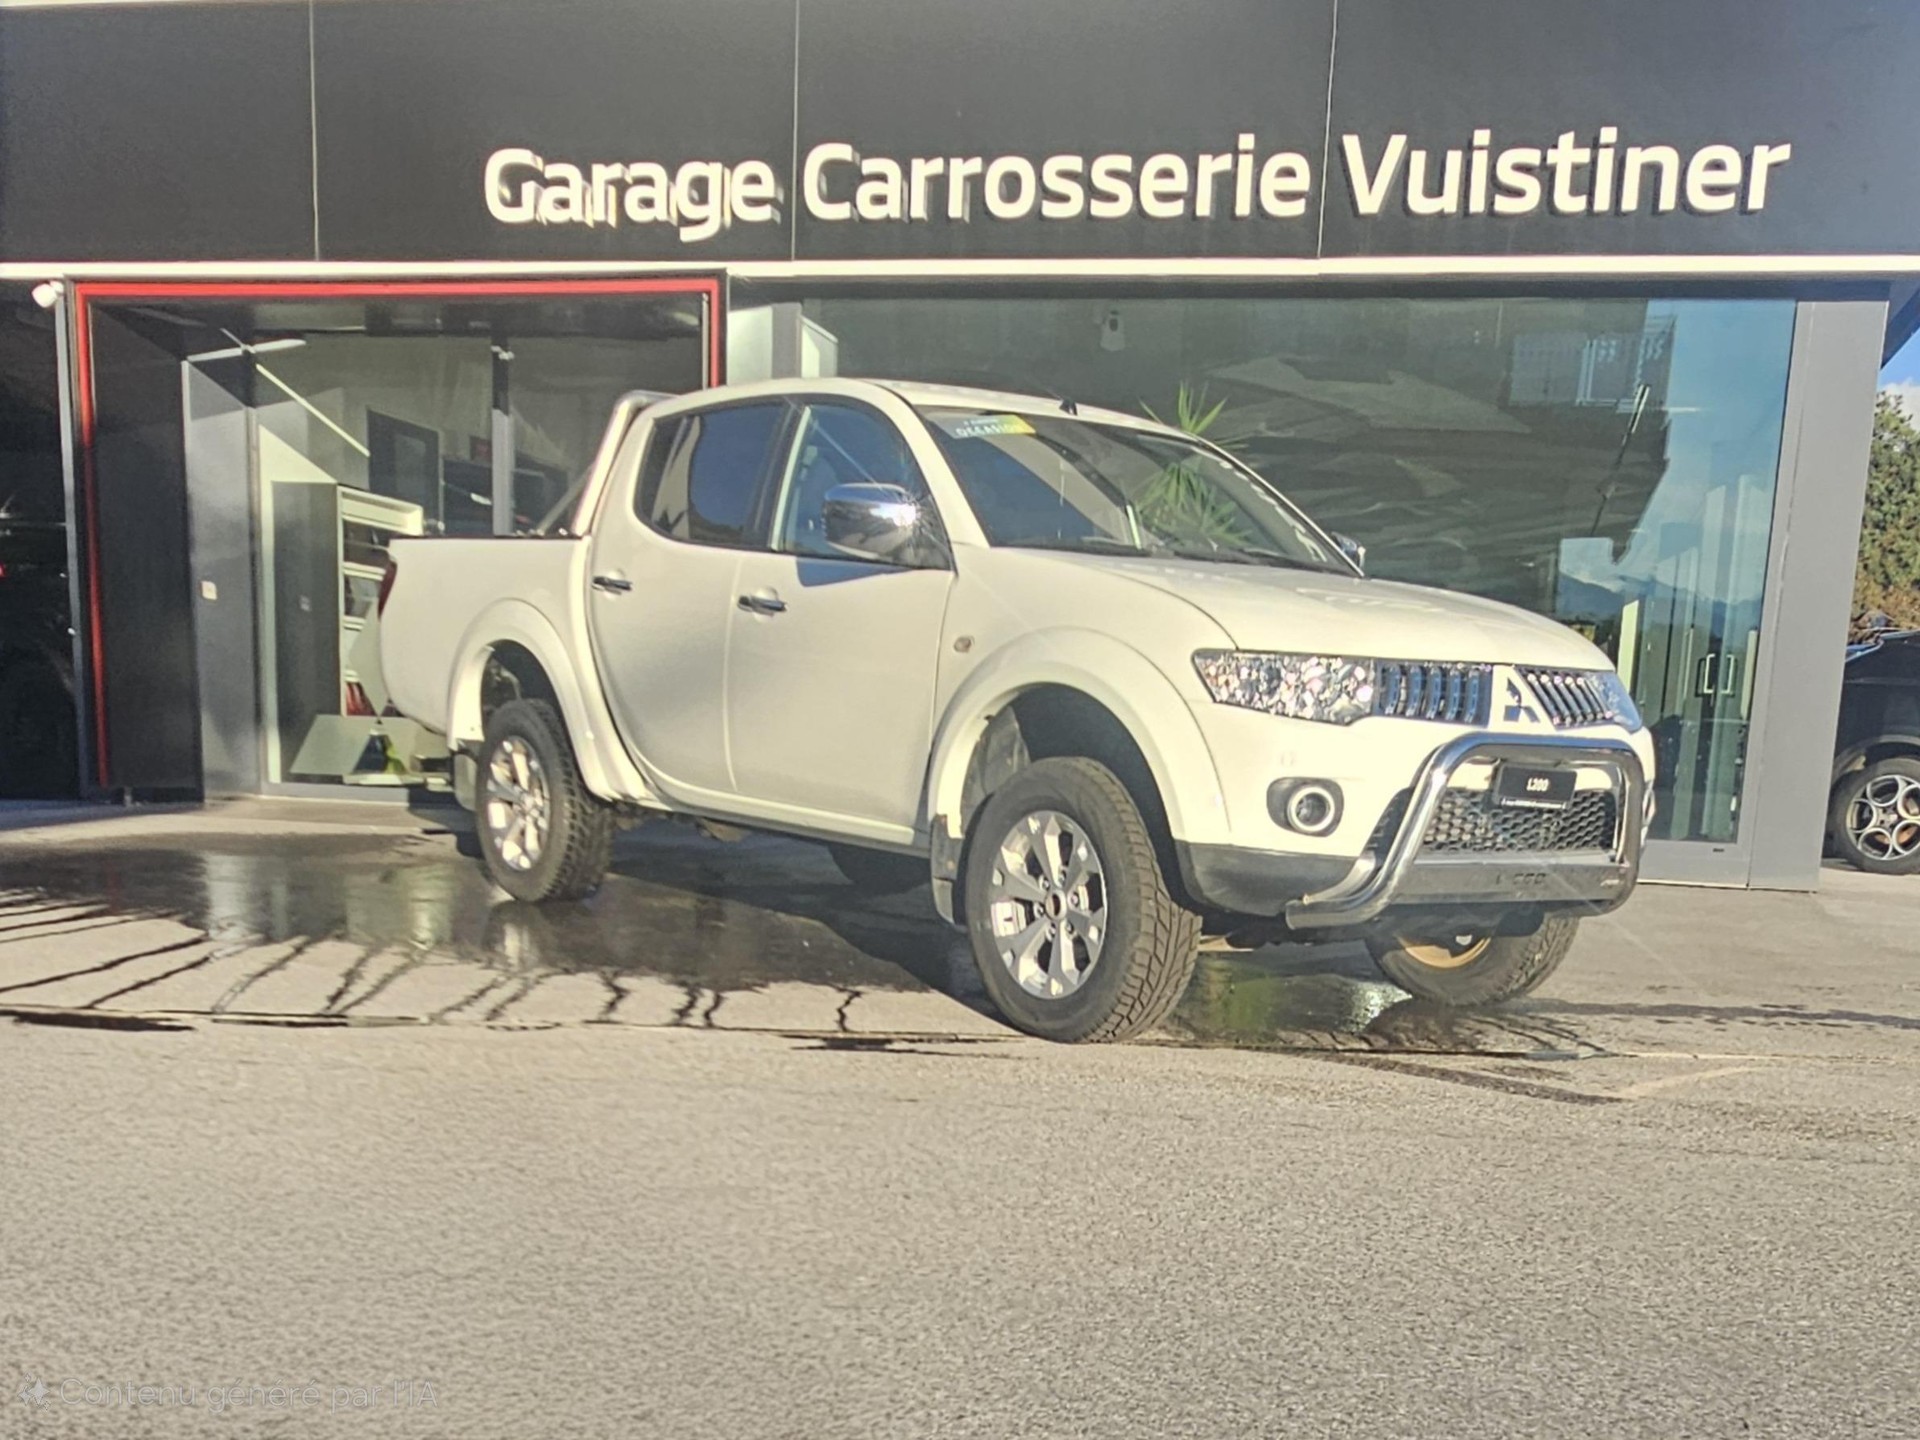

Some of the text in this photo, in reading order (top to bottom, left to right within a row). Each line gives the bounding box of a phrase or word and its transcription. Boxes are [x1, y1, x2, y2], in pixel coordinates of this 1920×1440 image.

[485, 126, 1791, 242] Garage Carrosserie Vuistiner
[1526, 778, 1549, 792] L200
